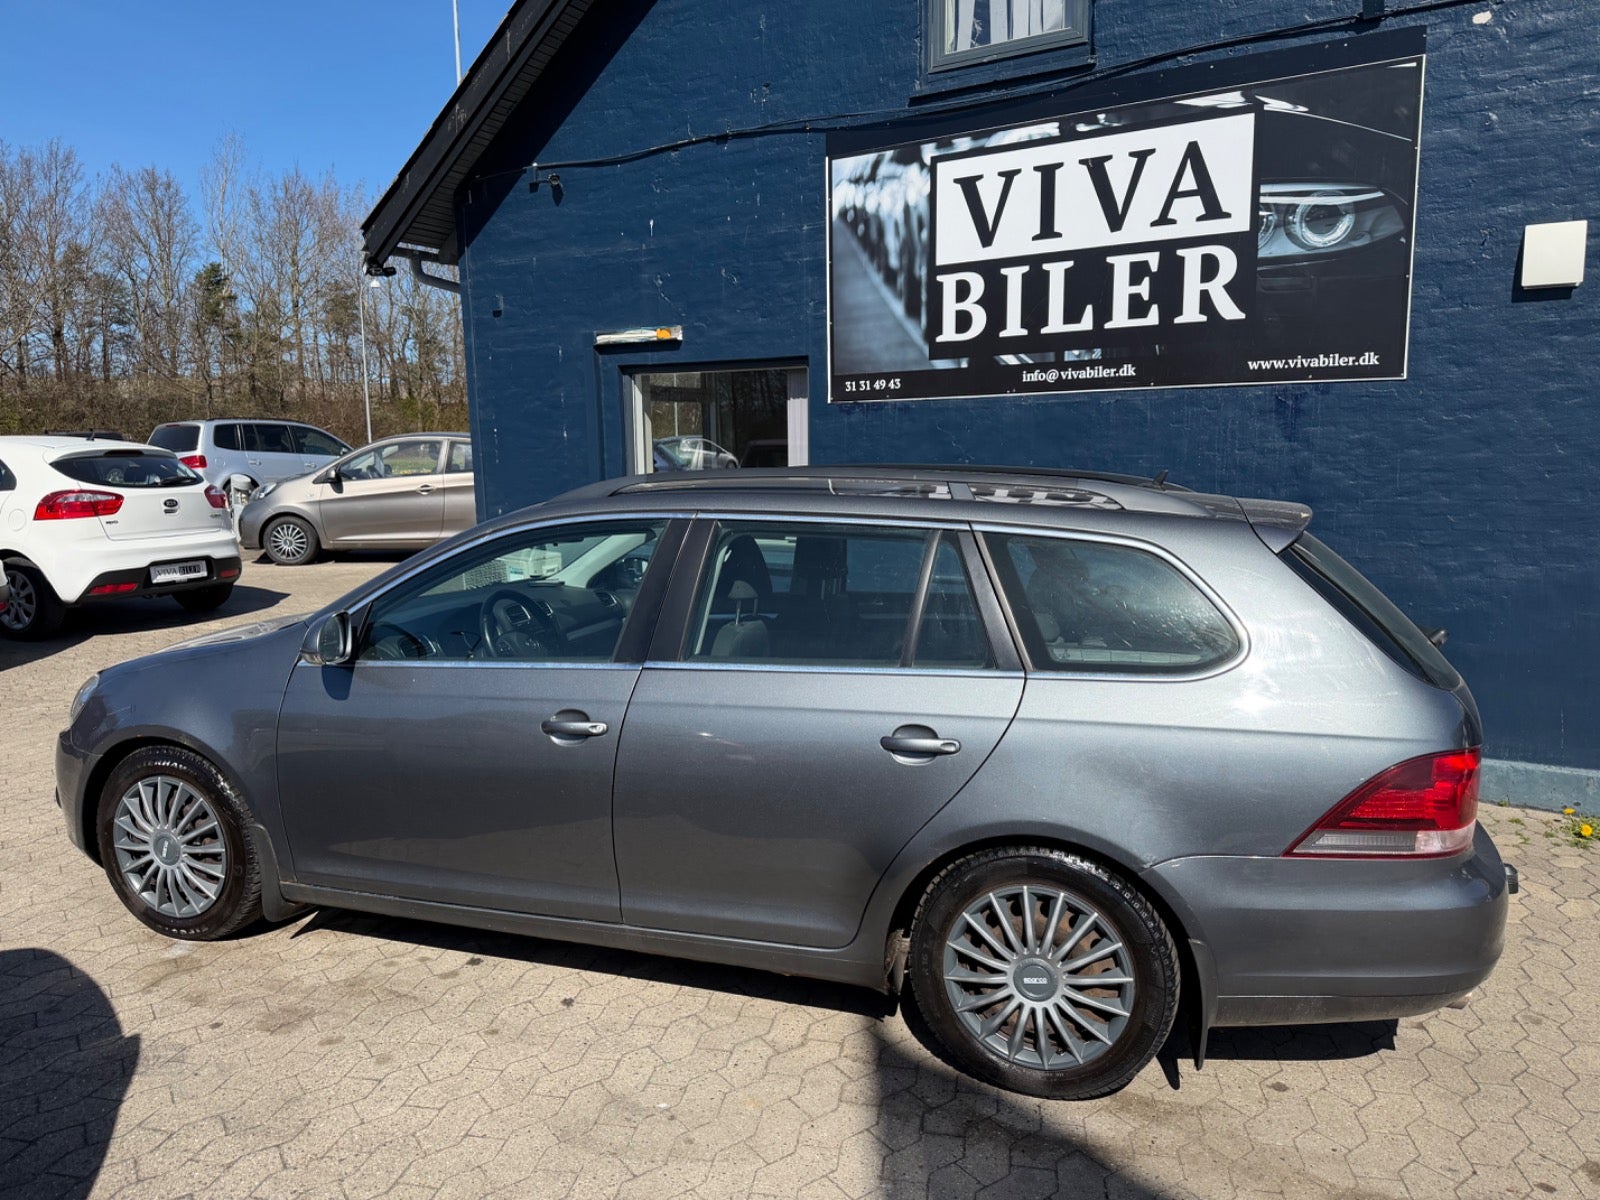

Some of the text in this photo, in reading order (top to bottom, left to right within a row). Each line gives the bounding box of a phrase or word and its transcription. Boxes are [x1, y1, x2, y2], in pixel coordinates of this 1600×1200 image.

[953, 140, 1232, 248] VIVA
[935, 245, 1246, 342] BILER
[1247, 351, 1380, 370] www.vivabiler.dk
[1022, 364, 1136, 383] info@vivabiler.dk
[845, 378, 901, 392] 31 31 49 43
